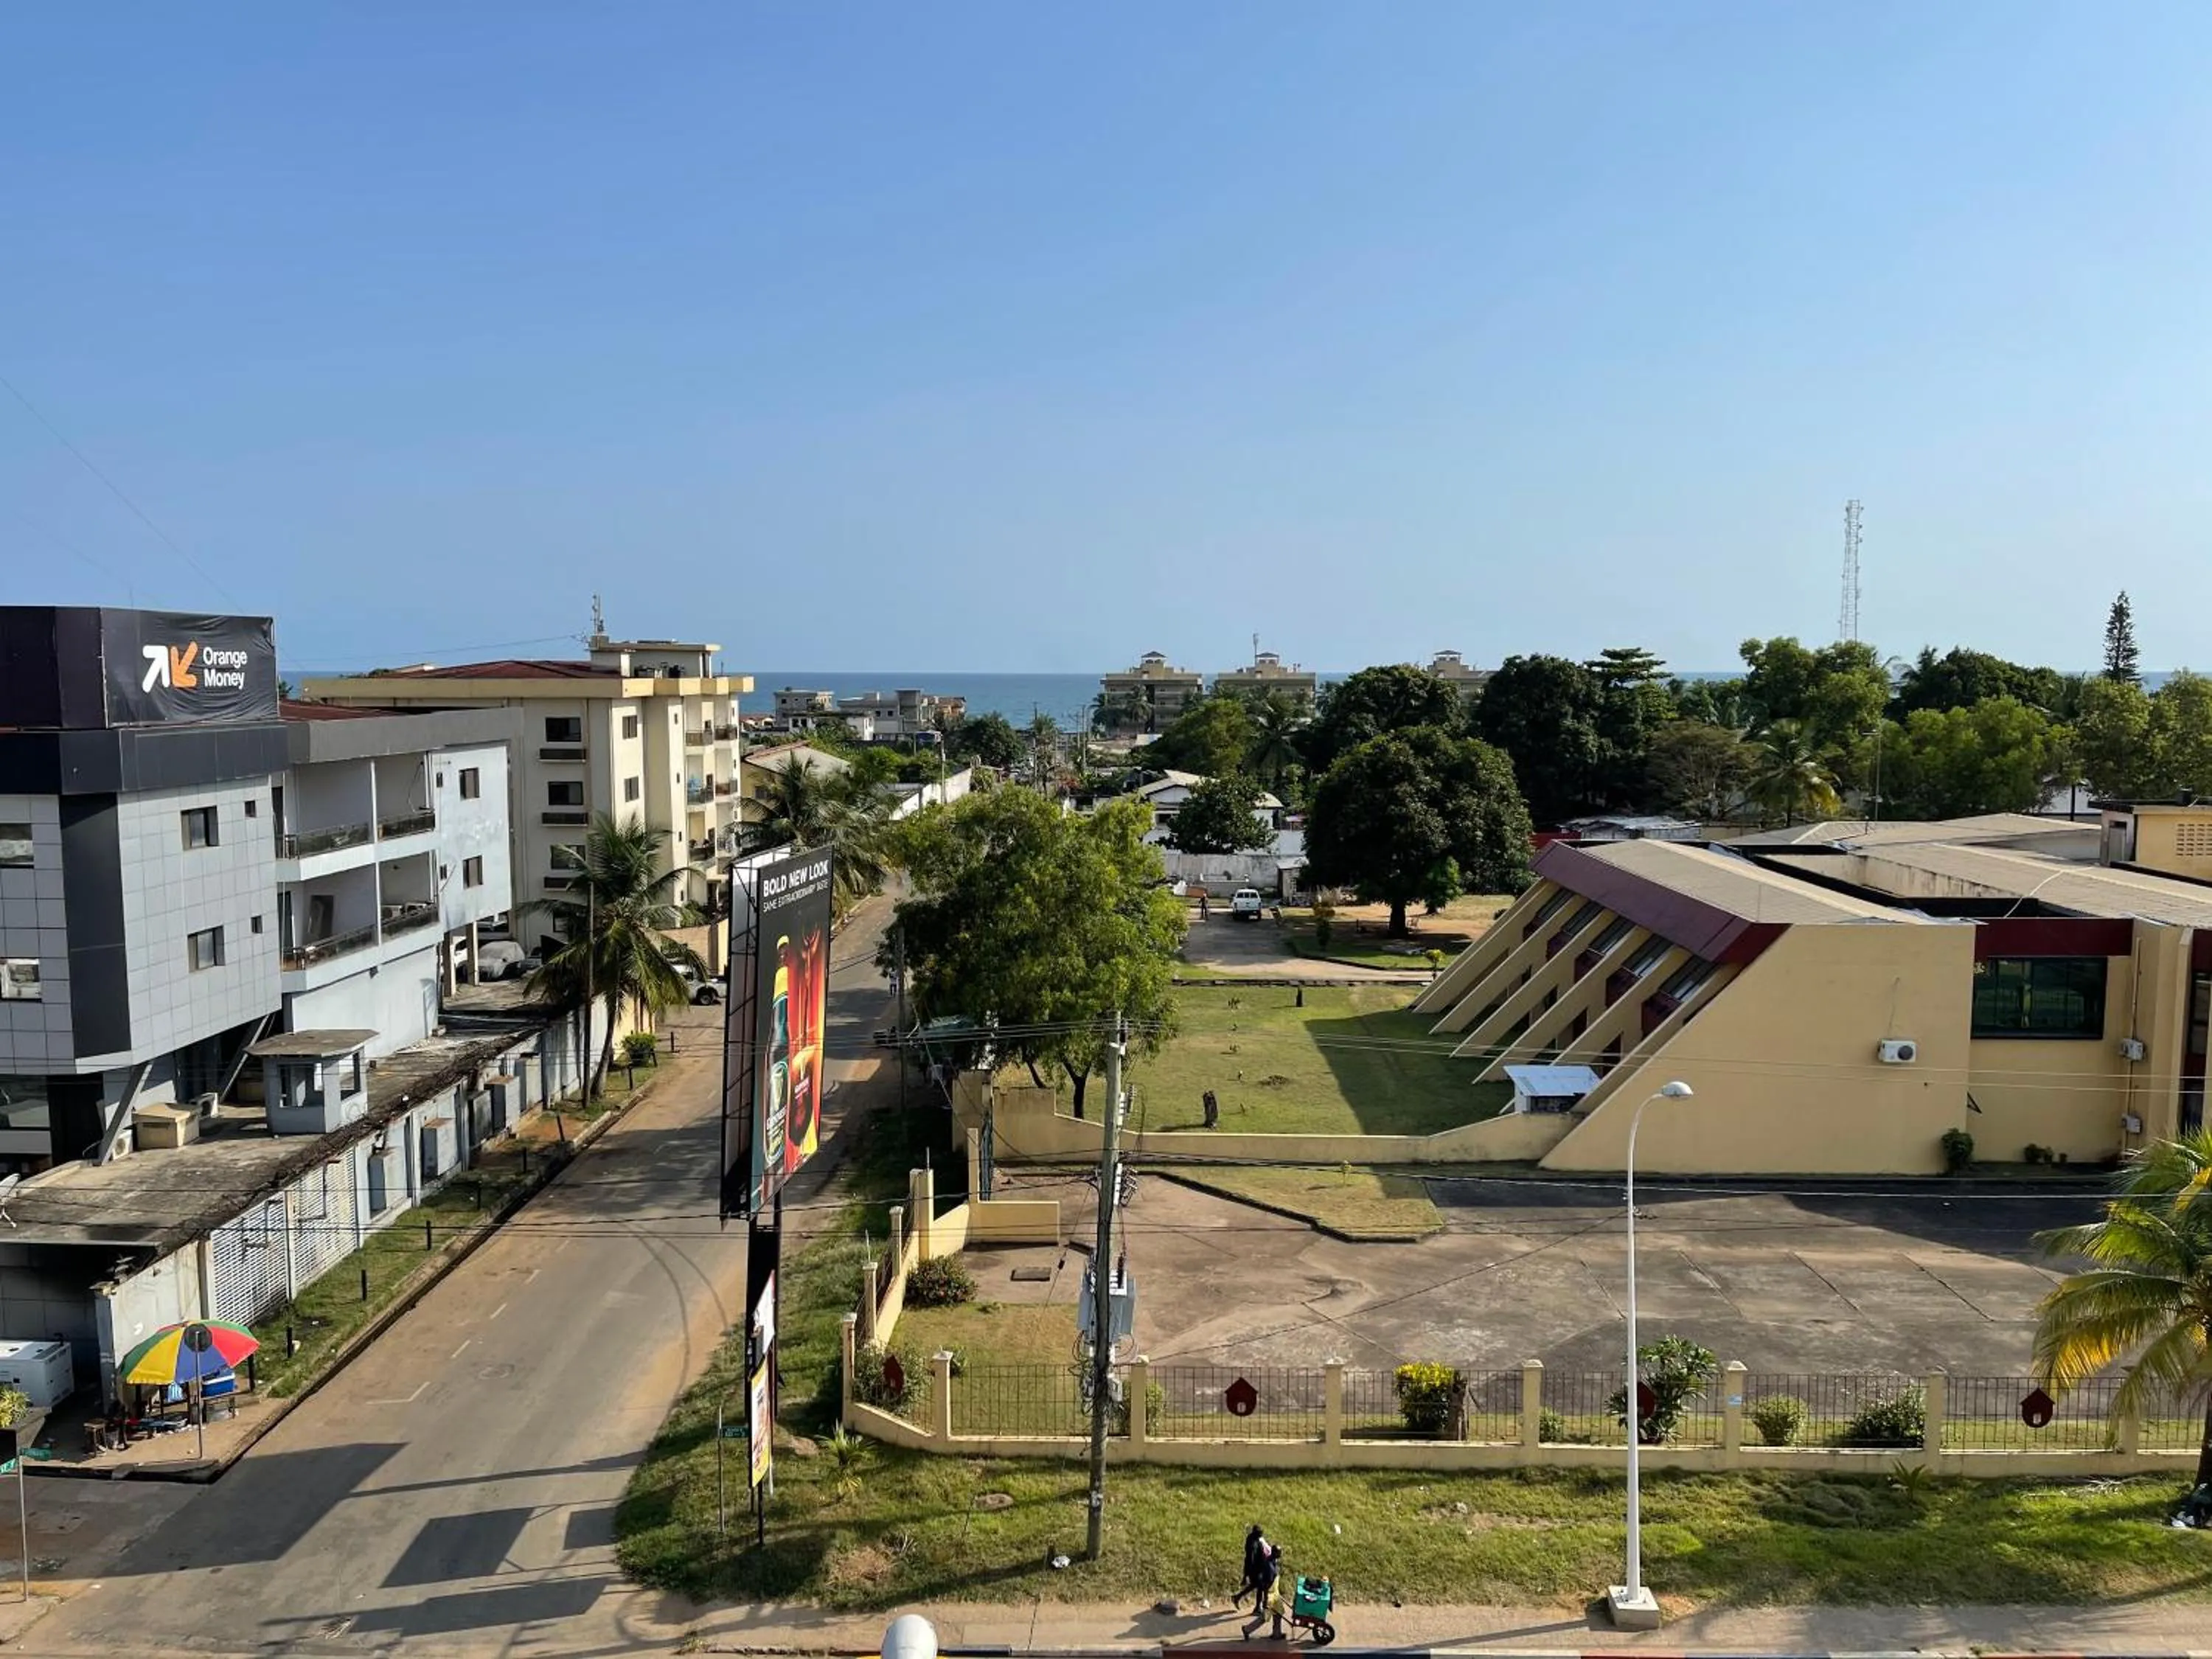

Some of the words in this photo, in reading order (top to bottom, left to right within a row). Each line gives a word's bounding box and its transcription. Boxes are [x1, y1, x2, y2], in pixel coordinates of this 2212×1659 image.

[203, 647, 248, 669] Orange
[204, 669, 245, 689] Money
[763, 874, 787, 897] BOLD
[788, 866, 808, 888] NEW
[809, 859, 829, 880] LOOK
[763, 899, 778, 912] SAME
